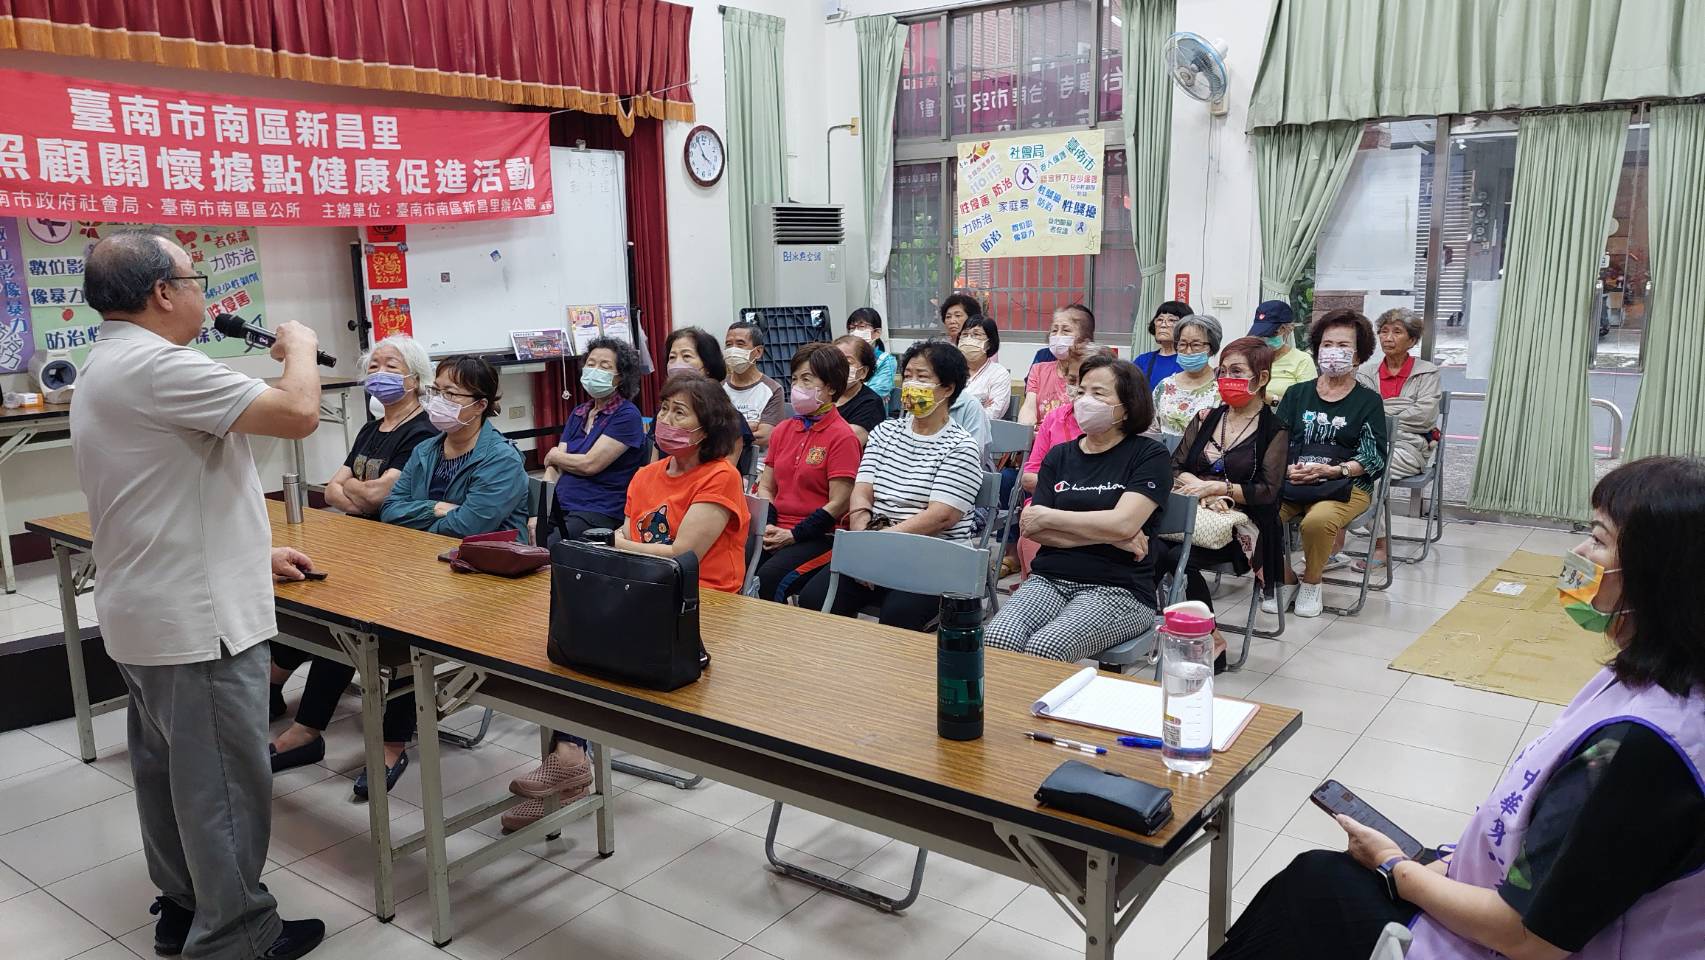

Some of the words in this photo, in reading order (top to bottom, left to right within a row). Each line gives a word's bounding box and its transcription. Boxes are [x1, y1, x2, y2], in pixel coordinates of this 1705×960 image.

[67, 87, 402, 151] 臺南市南區新昌里
[1010, 144, 1045, 159] 社會局
[1065, 136, 1096, 171] 臺南市
[0, 133, 535, 197] 照顧關懷據點健康促進活動
[991, 177, 1013, 198] 防治
[962, 213, 993, 235] 力防治
[29, 258, 85, 275] 數位影
[209, 247, 256, 272] 力防治
[31, 288, 86, 304] 像暴力
[1054, 480, 1126, 494] Champion
